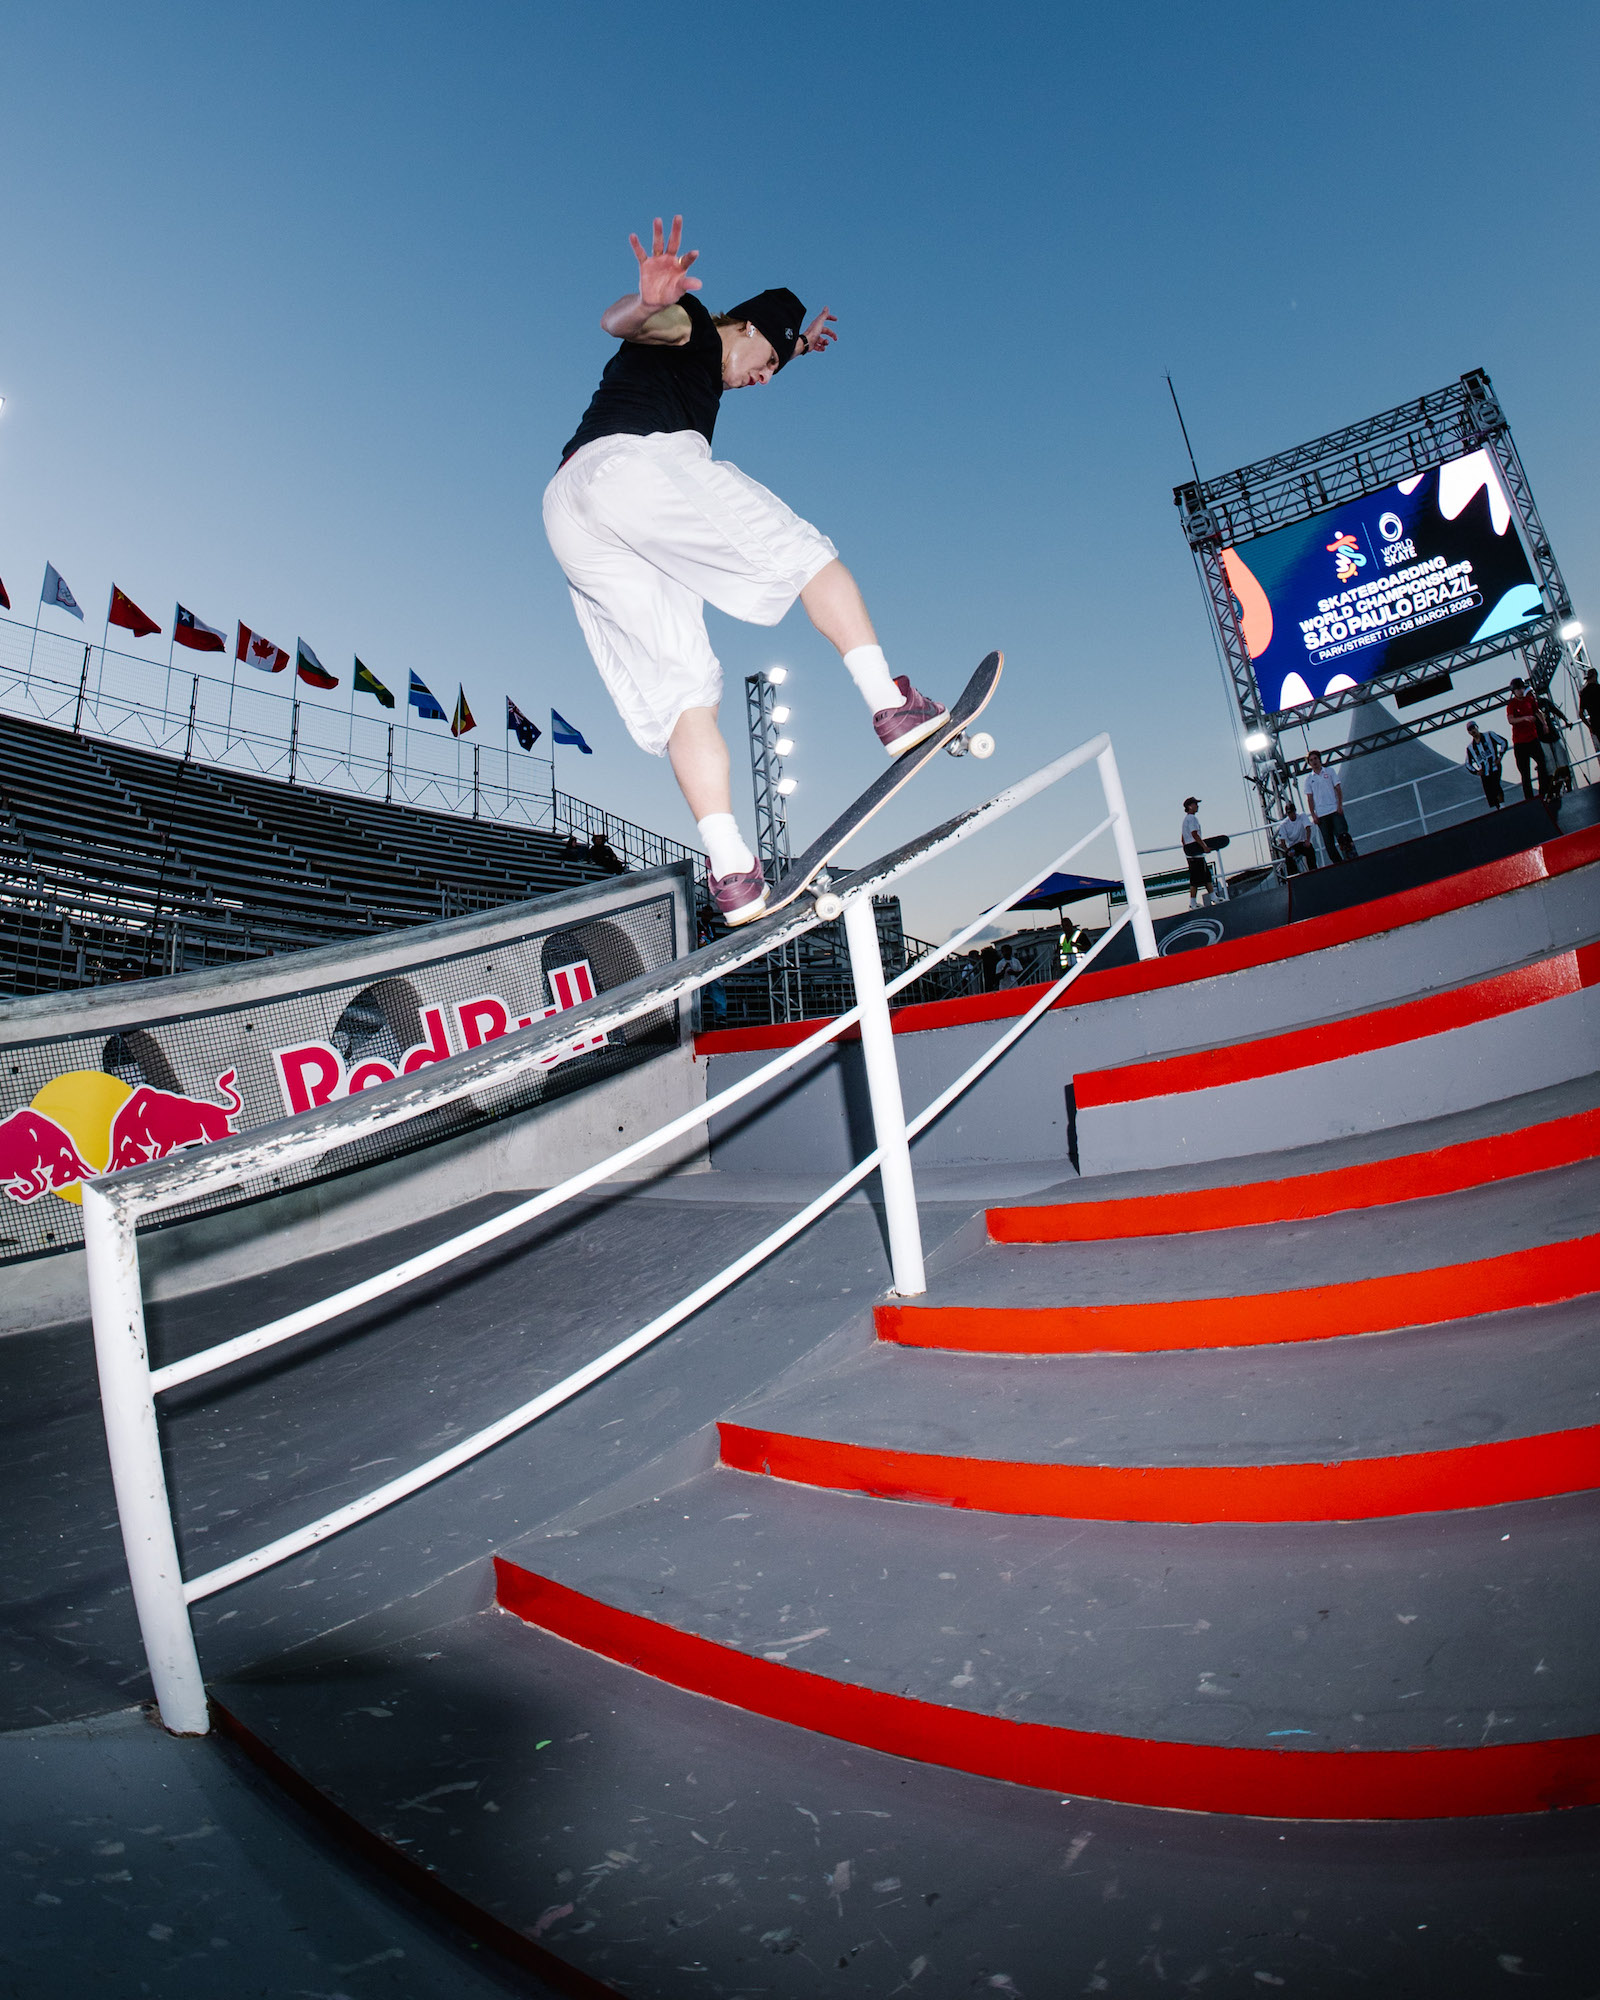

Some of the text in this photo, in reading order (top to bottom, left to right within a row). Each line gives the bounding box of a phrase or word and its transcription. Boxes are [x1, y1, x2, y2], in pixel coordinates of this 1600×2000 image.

[1380, 538, 1414, 557] WORLD
[1383, 546, 1418, 567] SKATE
[1299, 560, 1473, 633] WORLD CHAMPIONSHIPS
[1303, 574, 1478, 650] SÃO PAULO BRAZIL
[1317, 556, 1447, 613] SKATEBOARDING
[1318, 630, 1383, 661] PARK/STREET
[1388, 619, 1414, 636] 01-08
[1414, 606, 1450, 627] MARCH
